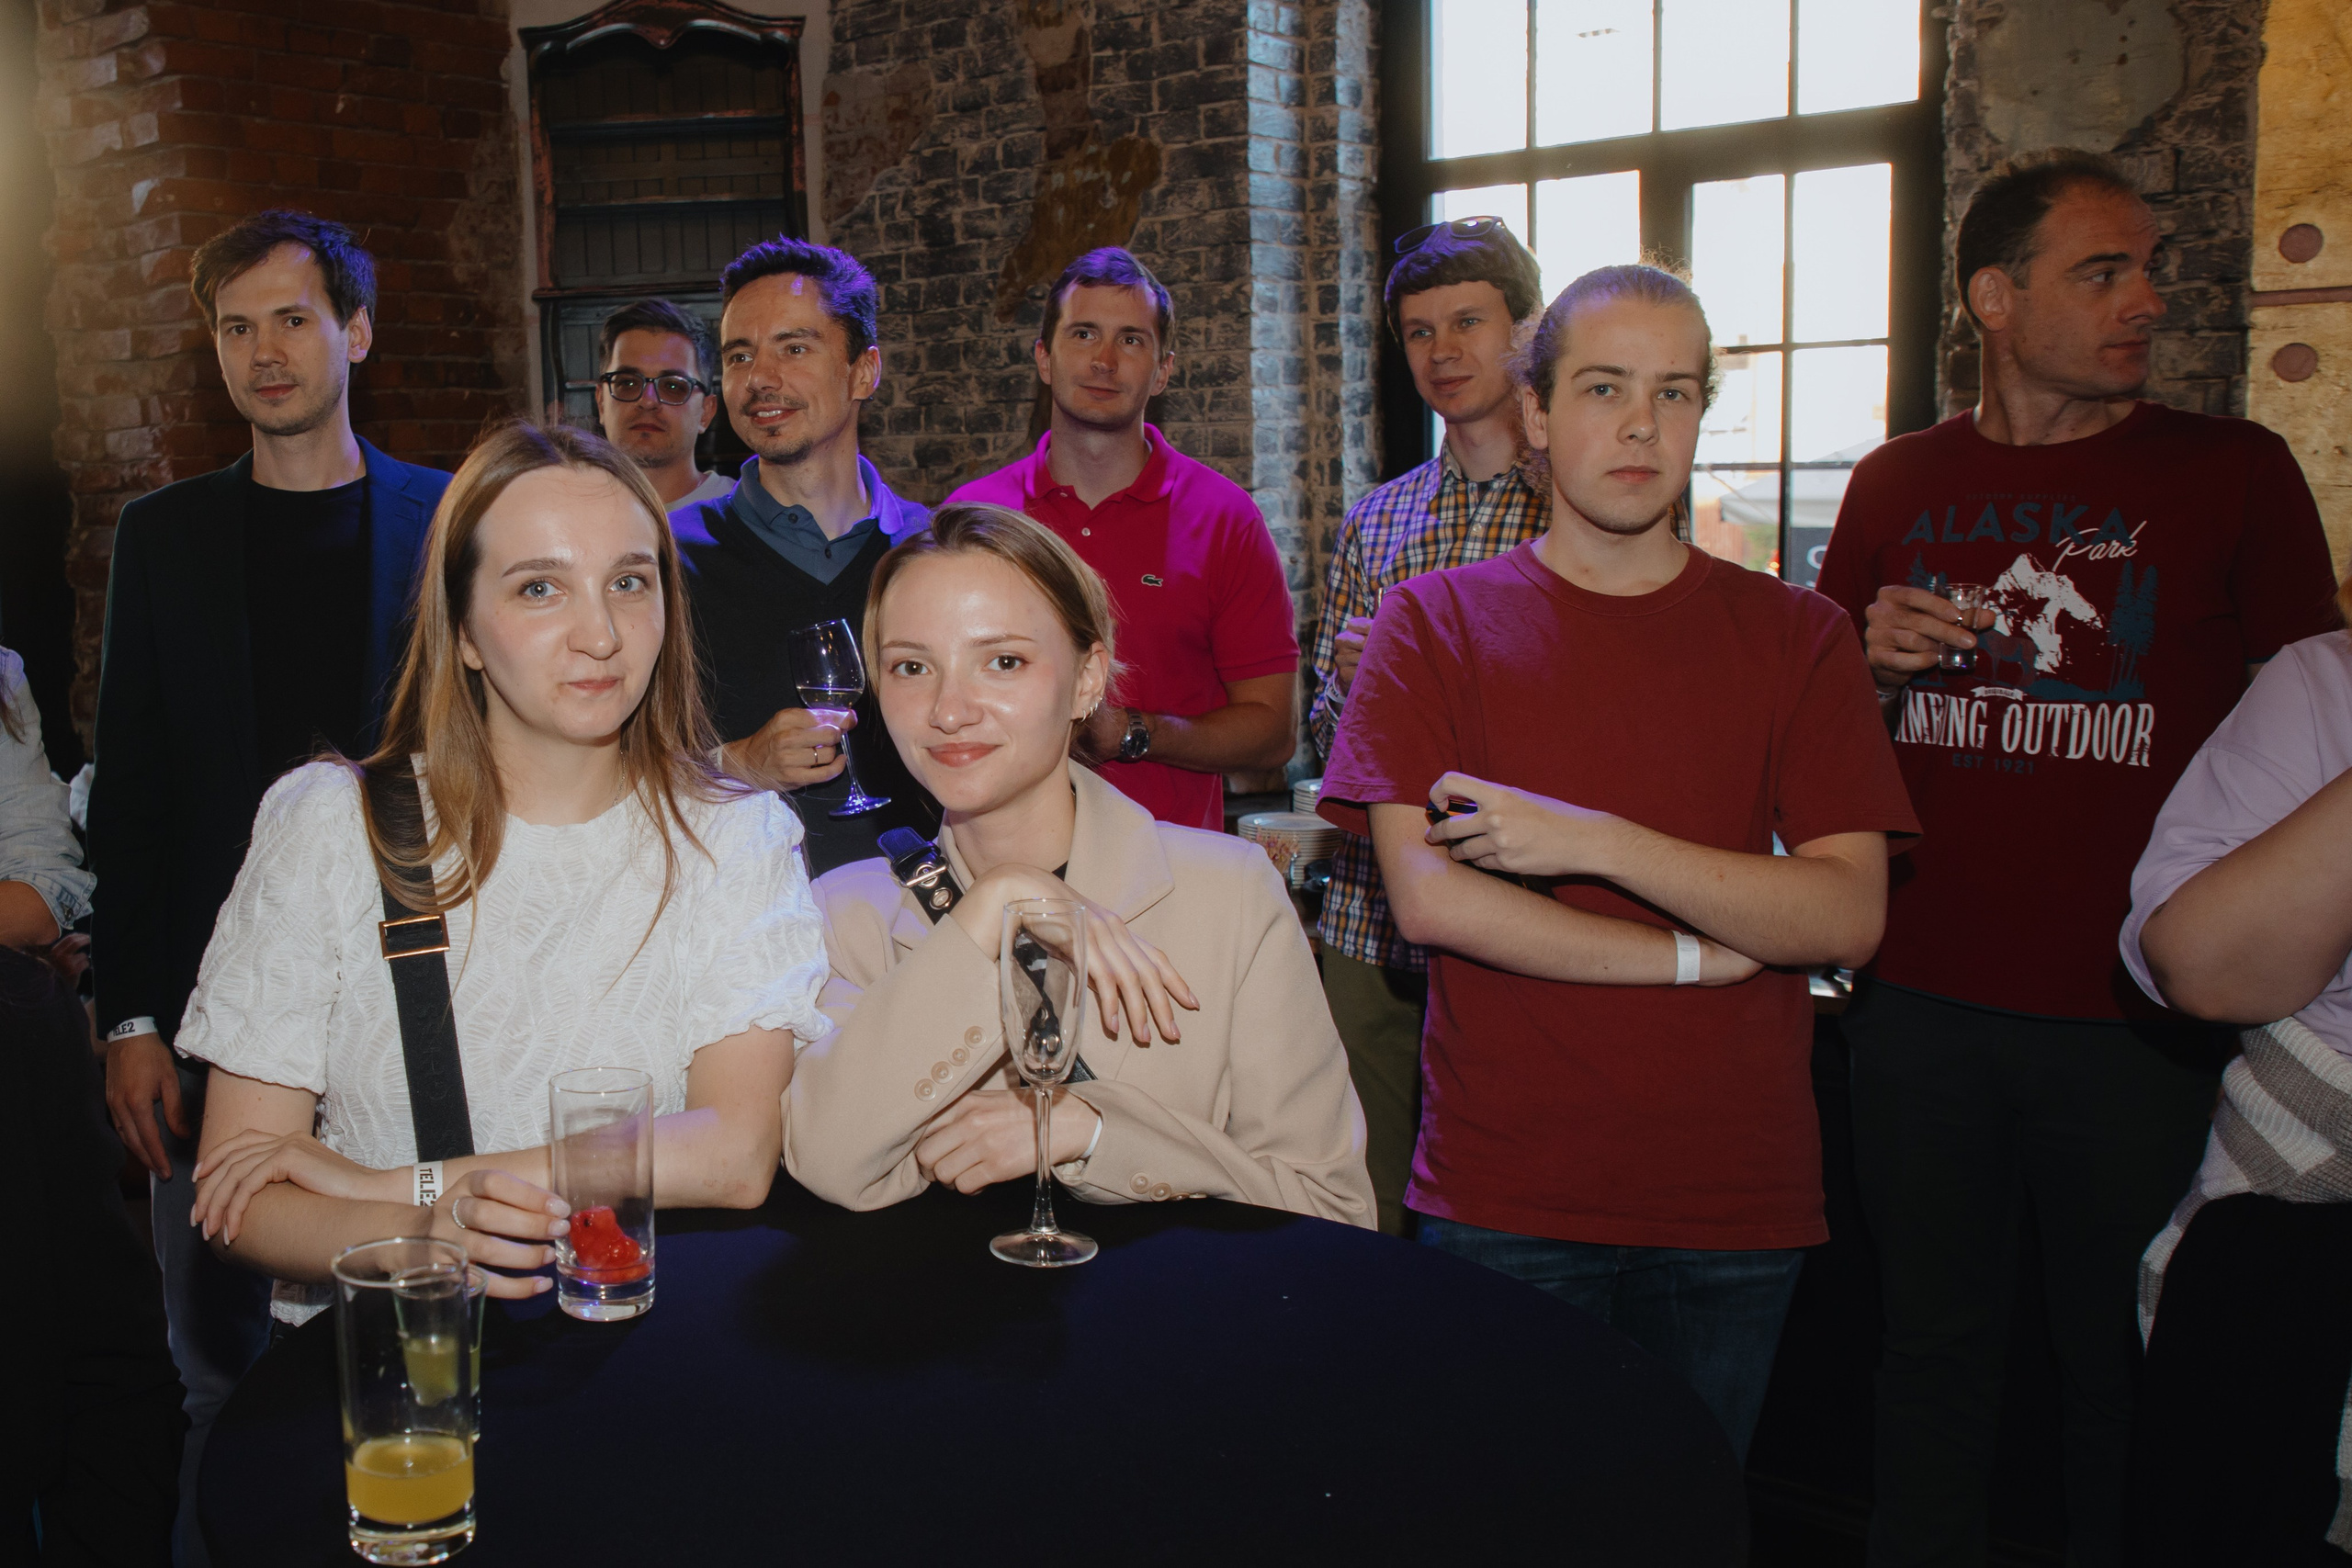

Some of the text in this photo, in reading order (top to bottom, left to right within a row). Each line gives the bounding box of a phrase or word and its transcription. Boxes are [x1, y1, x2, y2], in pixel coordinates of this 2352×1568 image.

[1902, 502, 2133, 547] ALASKA
[2052, 520, 2148, 572] Park
[2001, 703, 2156, 768] OUTDOOR
[1952, 753, 2034, 775] EST 1921
[114, 1021, 136, 1037] TELE2
